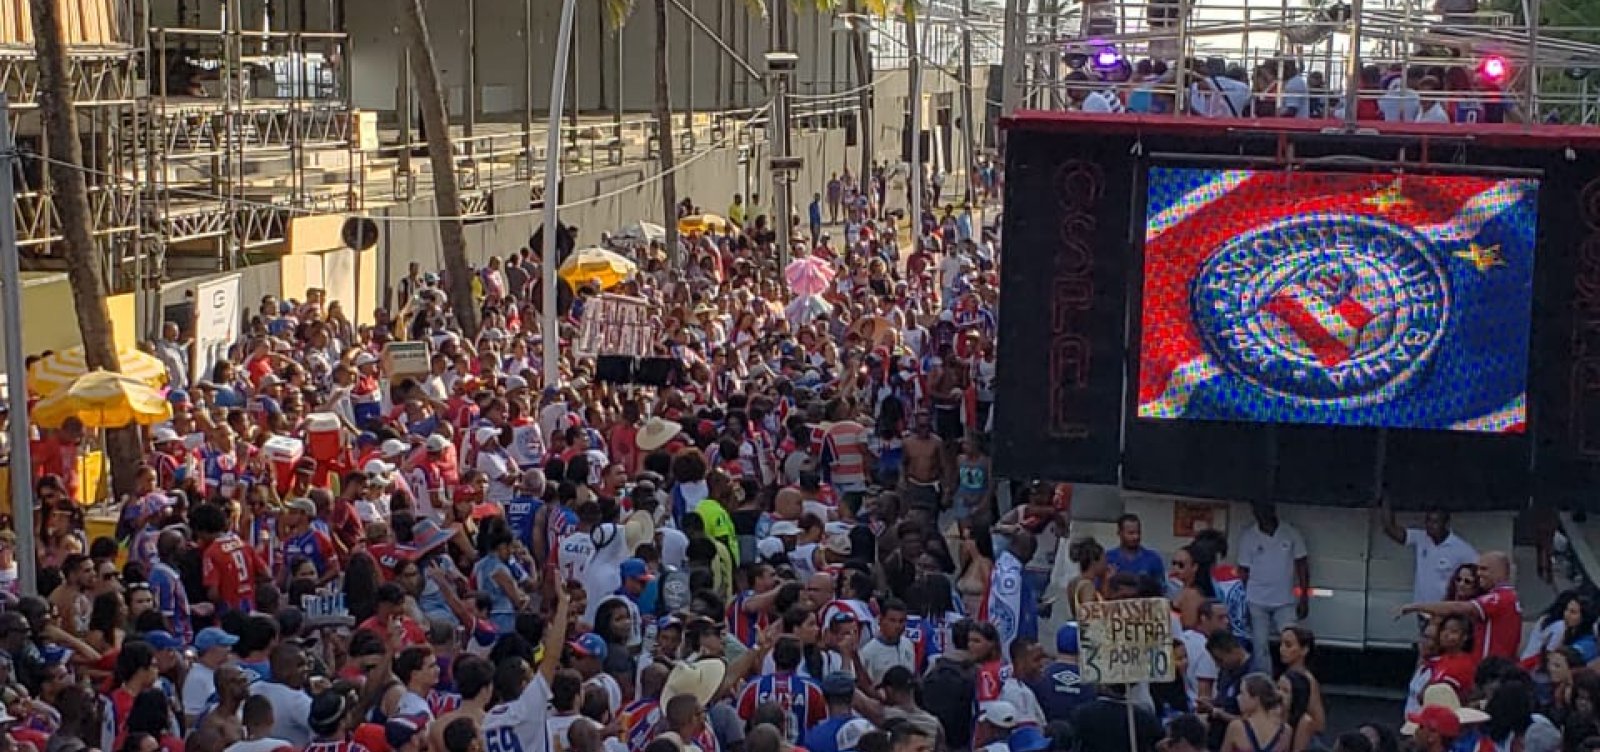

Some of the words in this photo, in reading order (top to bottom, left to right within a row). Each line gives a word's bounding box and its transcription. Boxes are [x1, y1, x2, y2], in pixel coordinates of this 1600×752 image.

[1080, 622, 1091, 641] E
[1111, 618, 1166, 643] PETRA
[1081, 643, 1102, 682] 3
[1146, 647, 1169, 679] 10
